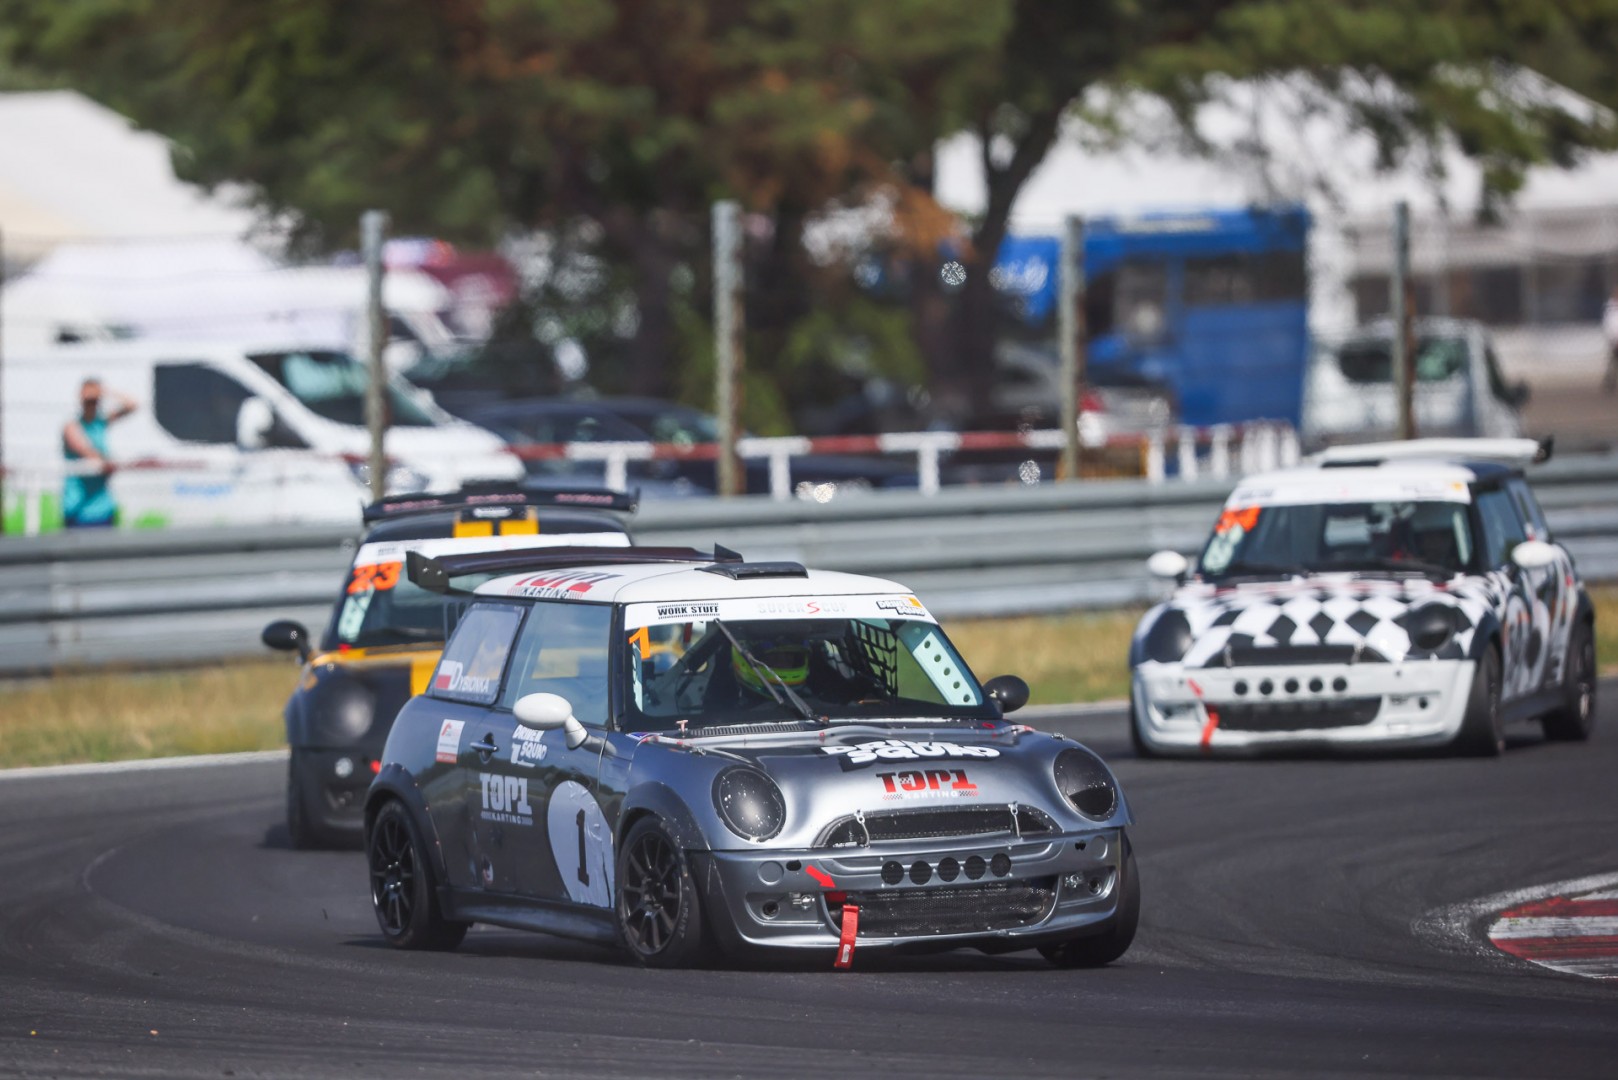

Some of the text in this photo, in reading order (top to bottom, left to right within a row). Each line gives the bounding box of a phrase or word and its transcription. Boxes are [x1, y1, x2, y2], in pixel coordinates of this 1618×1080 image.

[347, 561, 403, 593] 23
[657, 605, 719, 616] WORK STUFF
[628, 625, 651, 661] 1
[479, 772, 533, 815] TOP1
[575, 808, 590, 888] 1
